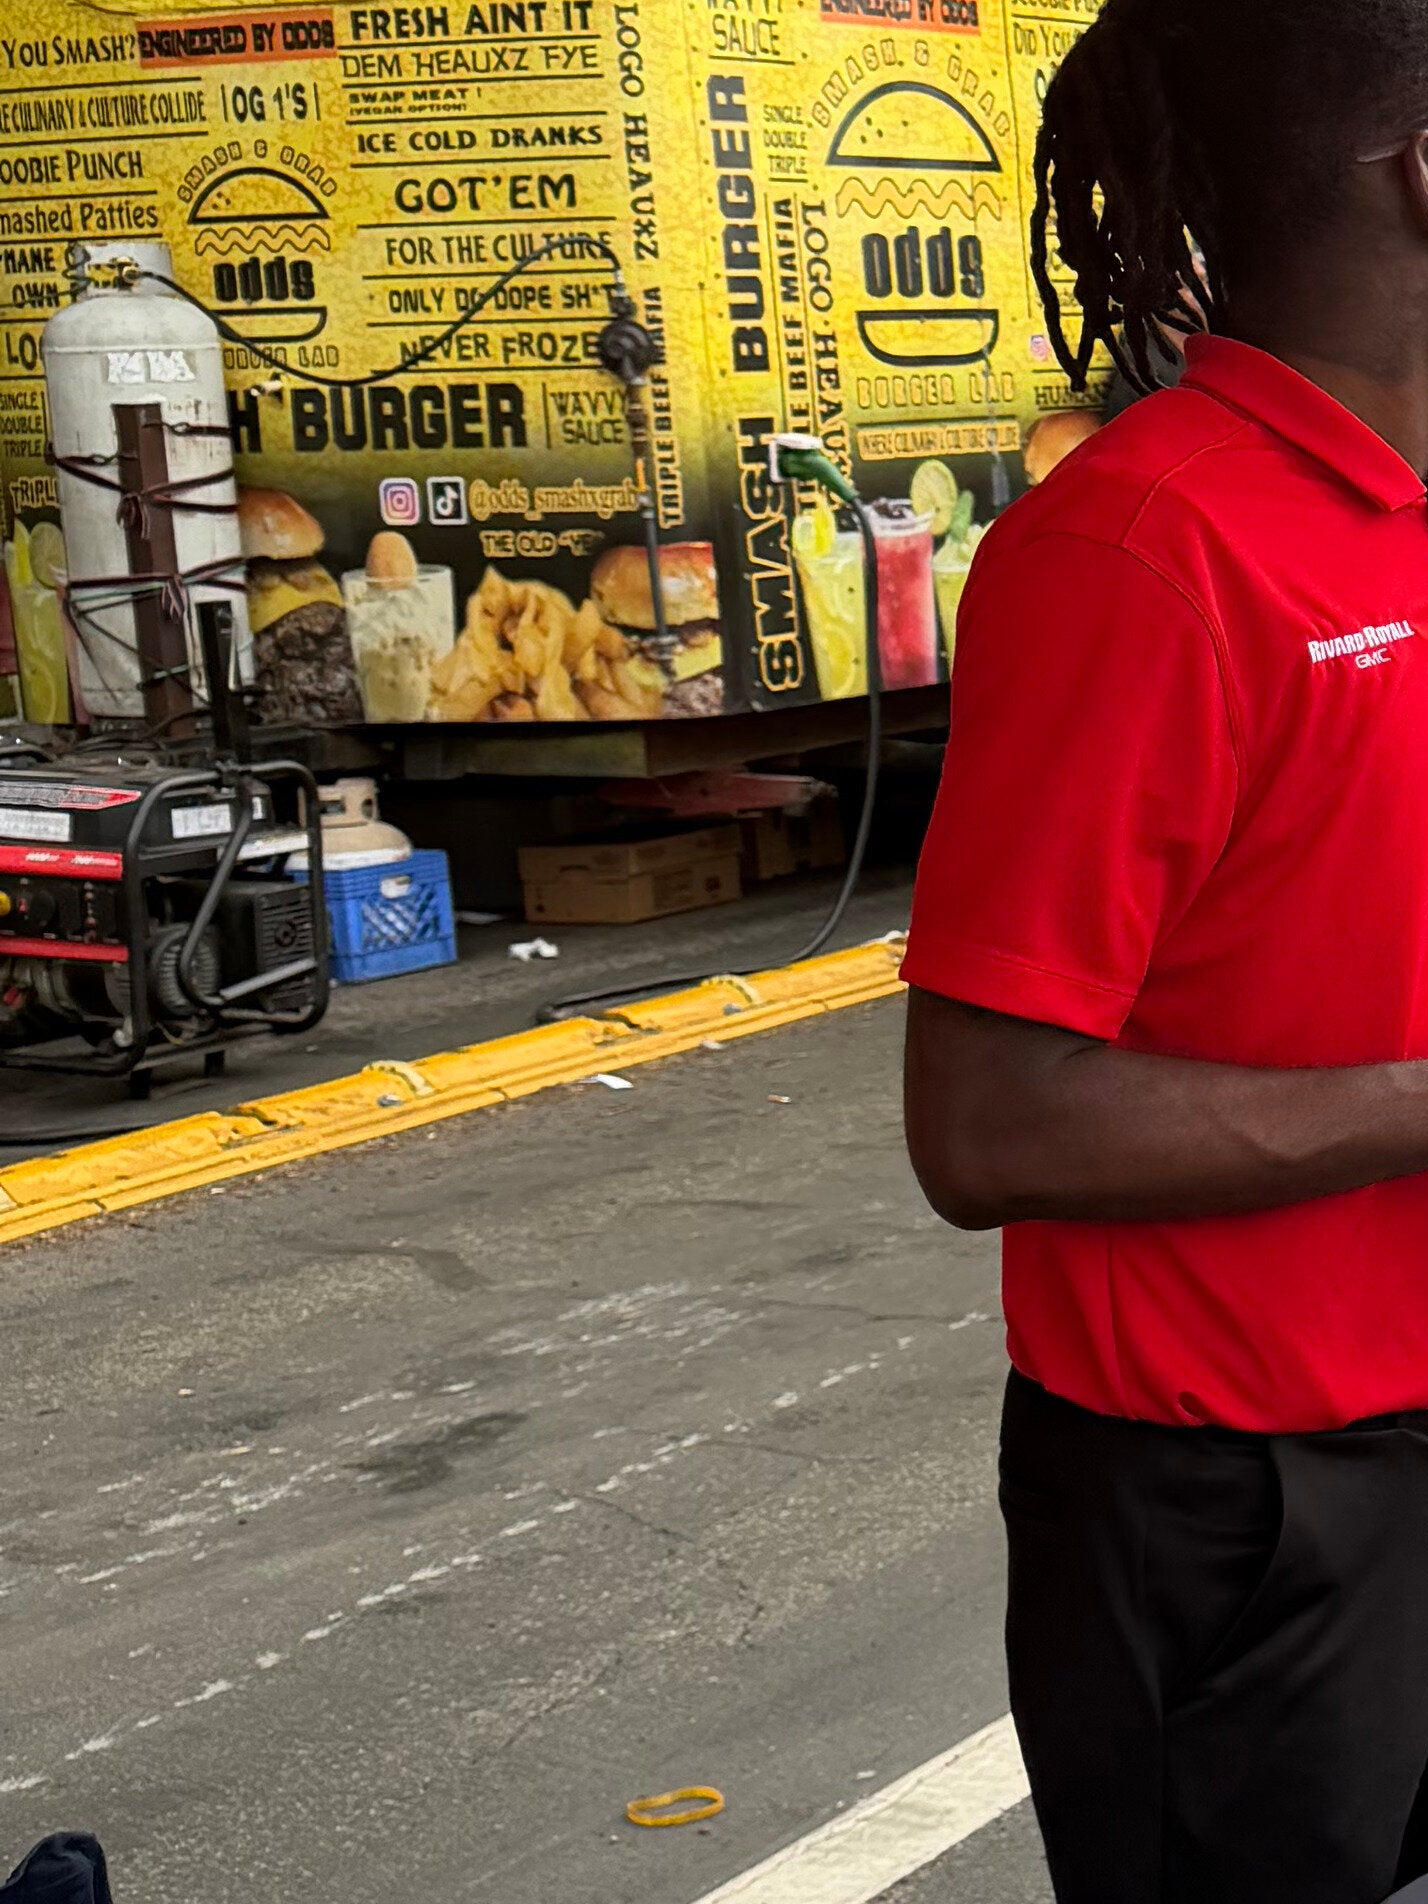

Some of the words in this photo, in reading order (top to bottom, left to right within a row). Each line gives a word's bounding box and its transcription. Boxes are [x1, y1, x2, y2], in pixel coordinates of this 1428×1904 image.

[250, 21, 276, 53] BY
[350, 6, 450, 40] FRESH
[464, 1, 546, 35] AINT
[562, 0, 594, 30] IT
[712, 15, 781, 56] SAUCE
[341, 53, 403, 78] DEM
[411, 47, 530, 77] HEAUXZ
[541, 44, 599, 69] FYE
[613, 1, 646, 98] LOGO
[348, 88, 406, 105] SWAP
[411, 87, 470, 102] MEAT
[810, 38, 900, 128] SMASH
[11, 98, 75, 133] CULINARY
[86, 92, 149, 129] CULTURE
[149, 90, 208, 126] COLLIDE
[232, 85, 266, 124] OG
[762, 103, 804, 125] SINGLE
[357, 133, 397, 153] ICE
[408, 130, 477, 151] COLD
[490, 124, 602, 148] DRANKS
[763, 129, 808, 150] DOUBLE
[65, 148, 145, 183] PUNCH
[767, 154, 808, 175] TRIPLE
[393, 172, 578, 214] GOT'EM
[622, 111, 660, 261] HEAUXZ
[79, 199, 159, 231] Patties
[705, 74, 771, 373] BURGER
[384, 236, 437, 267] FOR
[441, 235, 486, 265] THE
[773, 197, 801, 304] MAFIA
[800, 197, 834, 314] LOGO
[860, 225, 986, 299] odds
[388, 286, 446, 314] ONLY
[496, 282, 554, 312] DOPE
[501, 331, 601, 364] FROZE
[781, 313, 808, 392] BEEF
[650, 372, 673, 432] BEEF
[856, 372, 957, 409] BURGER
[968, 371, 1016, 406] LAB
[291, 382, 528, 453] BURGER
[560, 417, 625, 446] SAUCE
[10, 477, 57, 511] TRIPL
[656, 439, 683, 522] TRIPLE
[737, 414, 804, 692] SMASH
[1354, 647, 1392, 670] GMC
